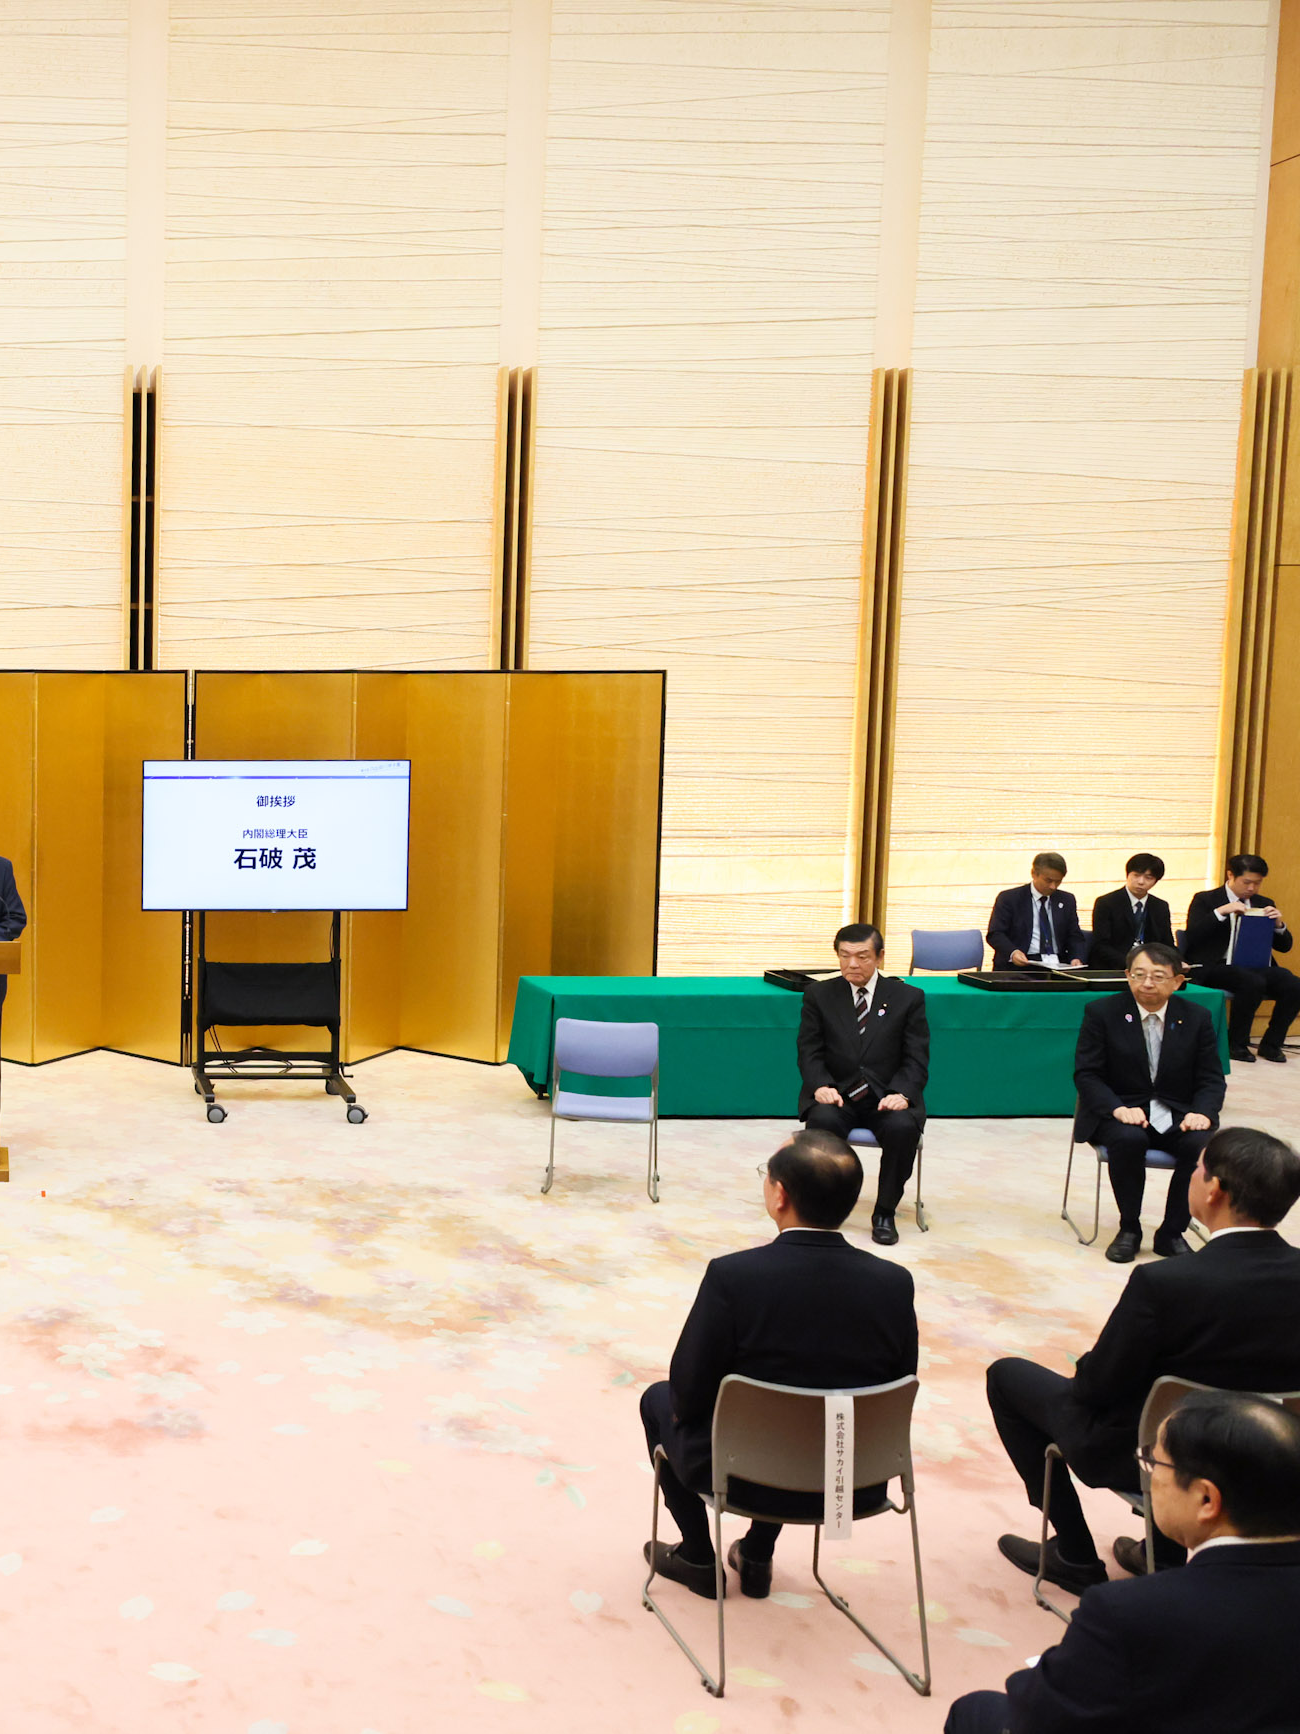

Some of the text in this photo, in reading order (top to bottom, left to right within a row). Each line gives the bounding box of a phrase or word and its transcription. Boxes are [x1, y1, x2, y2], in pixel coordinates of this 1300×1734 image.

[255, 794, 296, 808] 御挨拶
[242, 828, 309, 839] 内閣総理大臣
[233, 847, 317, 870] 石破 茂
[834, 1412, 845, 1529] 株式会社サカイ引越センター
